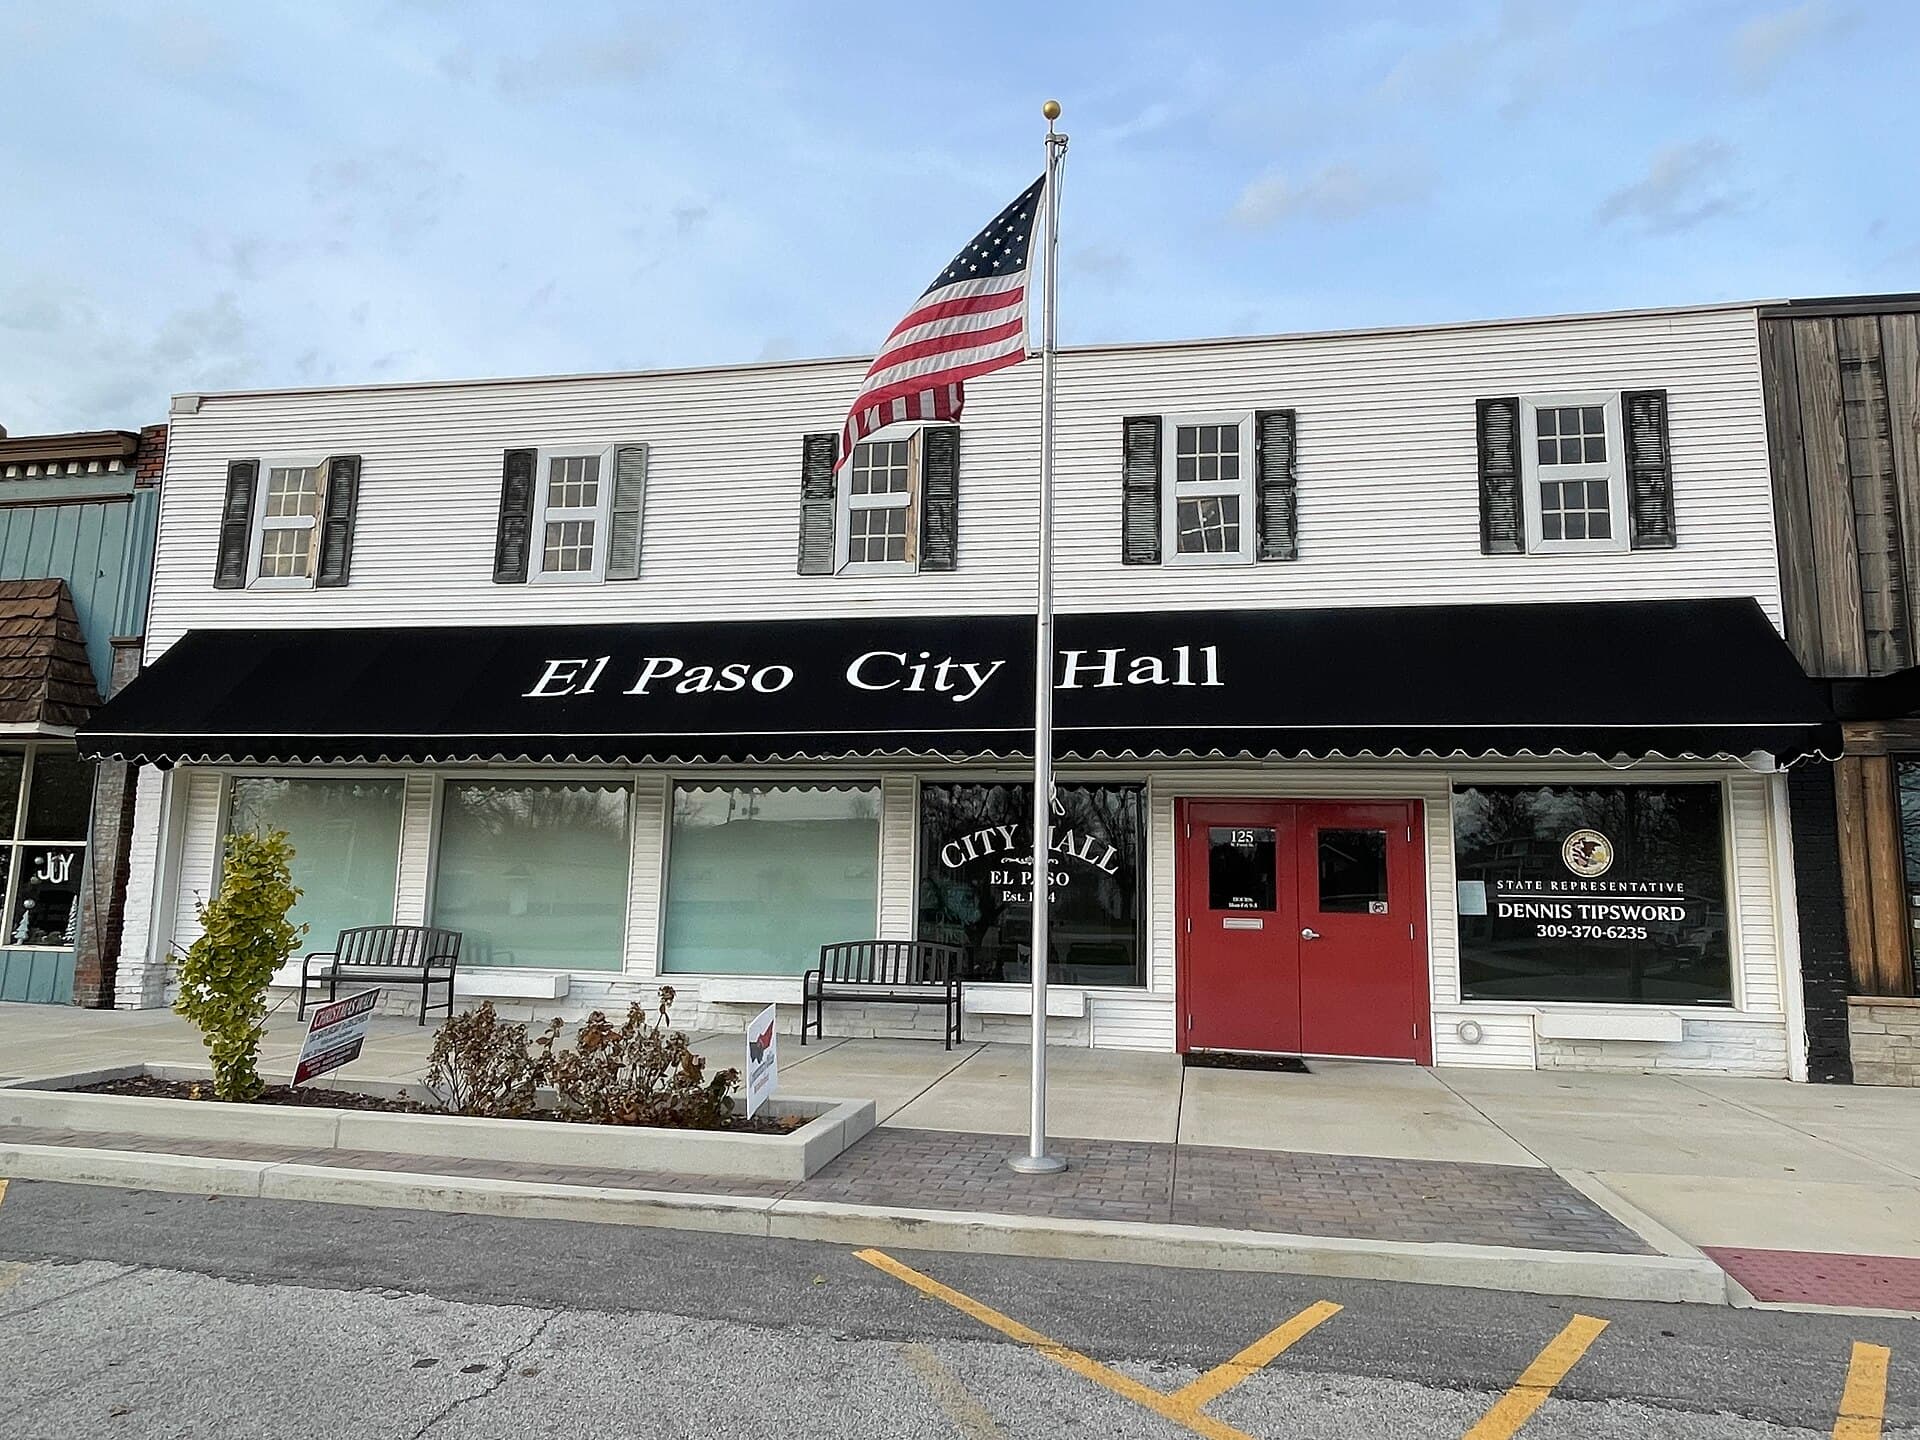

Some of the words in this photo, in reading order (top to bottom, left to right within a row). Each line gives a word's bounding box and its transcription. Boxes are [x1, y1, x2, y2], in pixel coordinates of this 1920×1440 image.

[522, 656, 610, 698] El
[623, 656, 796, 696] Paso
[846, 650, 1006, 702] City
[1054, 645, 1225, 690] Hall
[1231, 830, 1254, 843] 125
[941, 823, 1019, 868] CITY
[990, 871, 1014, 885] EL
[1021, 871, 1070, 887] PSO
[1496, 879, 1544, 891] STATE
[1550, 880, 1685, 893] REPRESENTATIVE
[1002, 890, 1025, 902] Est.
[1029, 890, 1057, 903] 14
[1498, 902, 1573, 920] DENNIS
[1577, 903, 1686, 921] TIPSWORD
[1536, 924, 1648, 940] 309-370-6235
